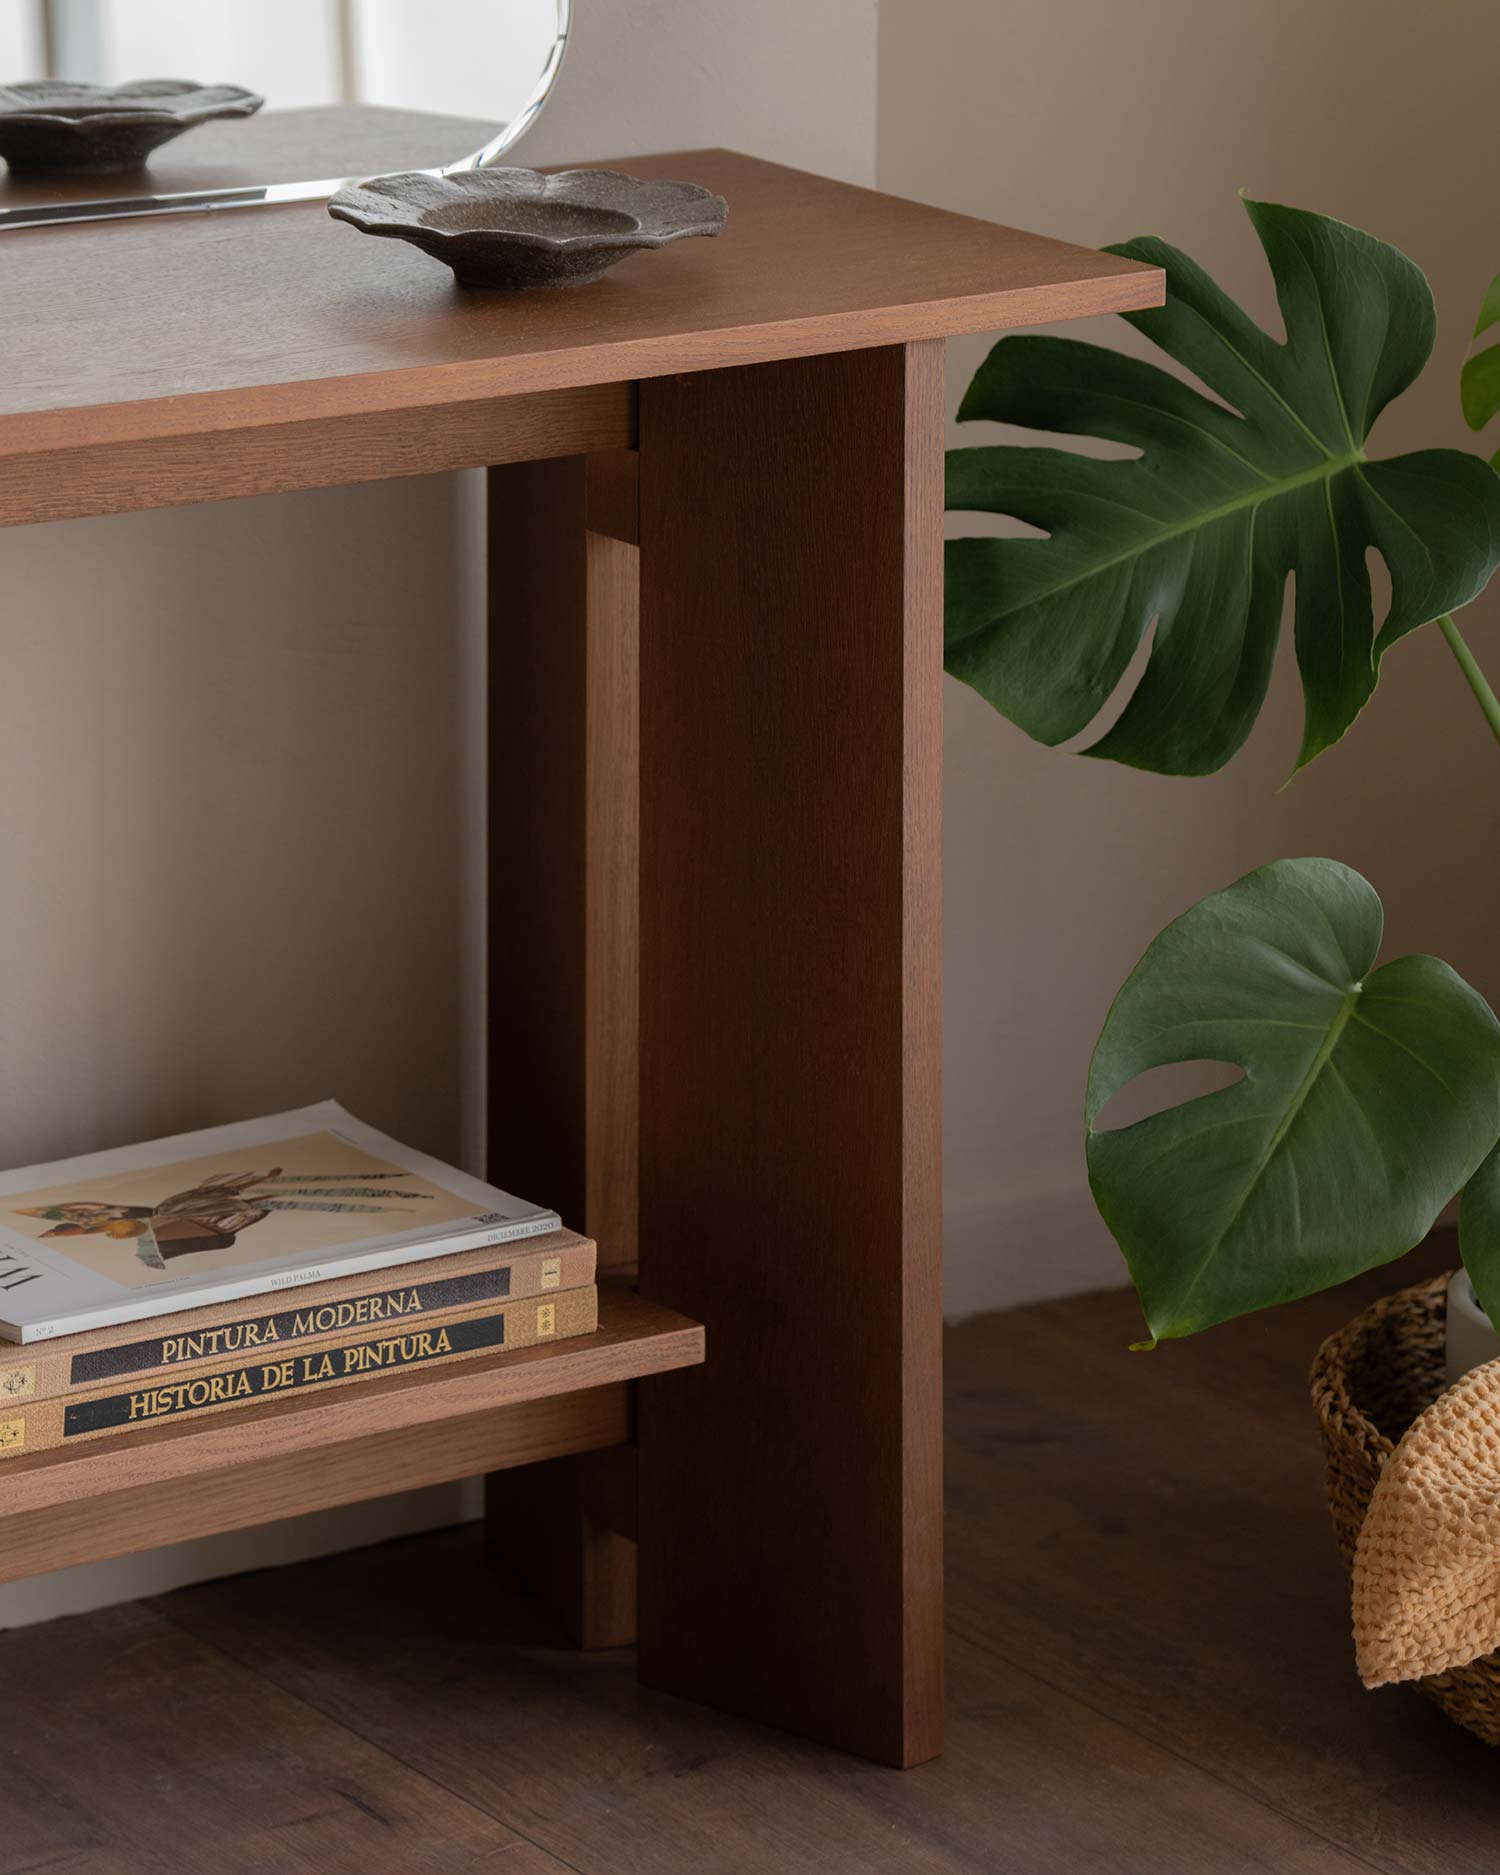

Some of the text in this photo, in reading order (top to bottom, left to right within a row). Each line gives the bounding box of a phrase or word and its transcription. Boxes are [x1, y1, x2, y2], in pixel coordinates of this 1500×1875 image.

[487, 1222, 554, 1242] DICIEMBRE 2020
[270, 1270, 321, 1287] WILD PALMA
[161, 1288, 423, 1364] PINTURA MODERNA
[129, 1327, 452, 1419] HISTORIA DE LA PINTURA
